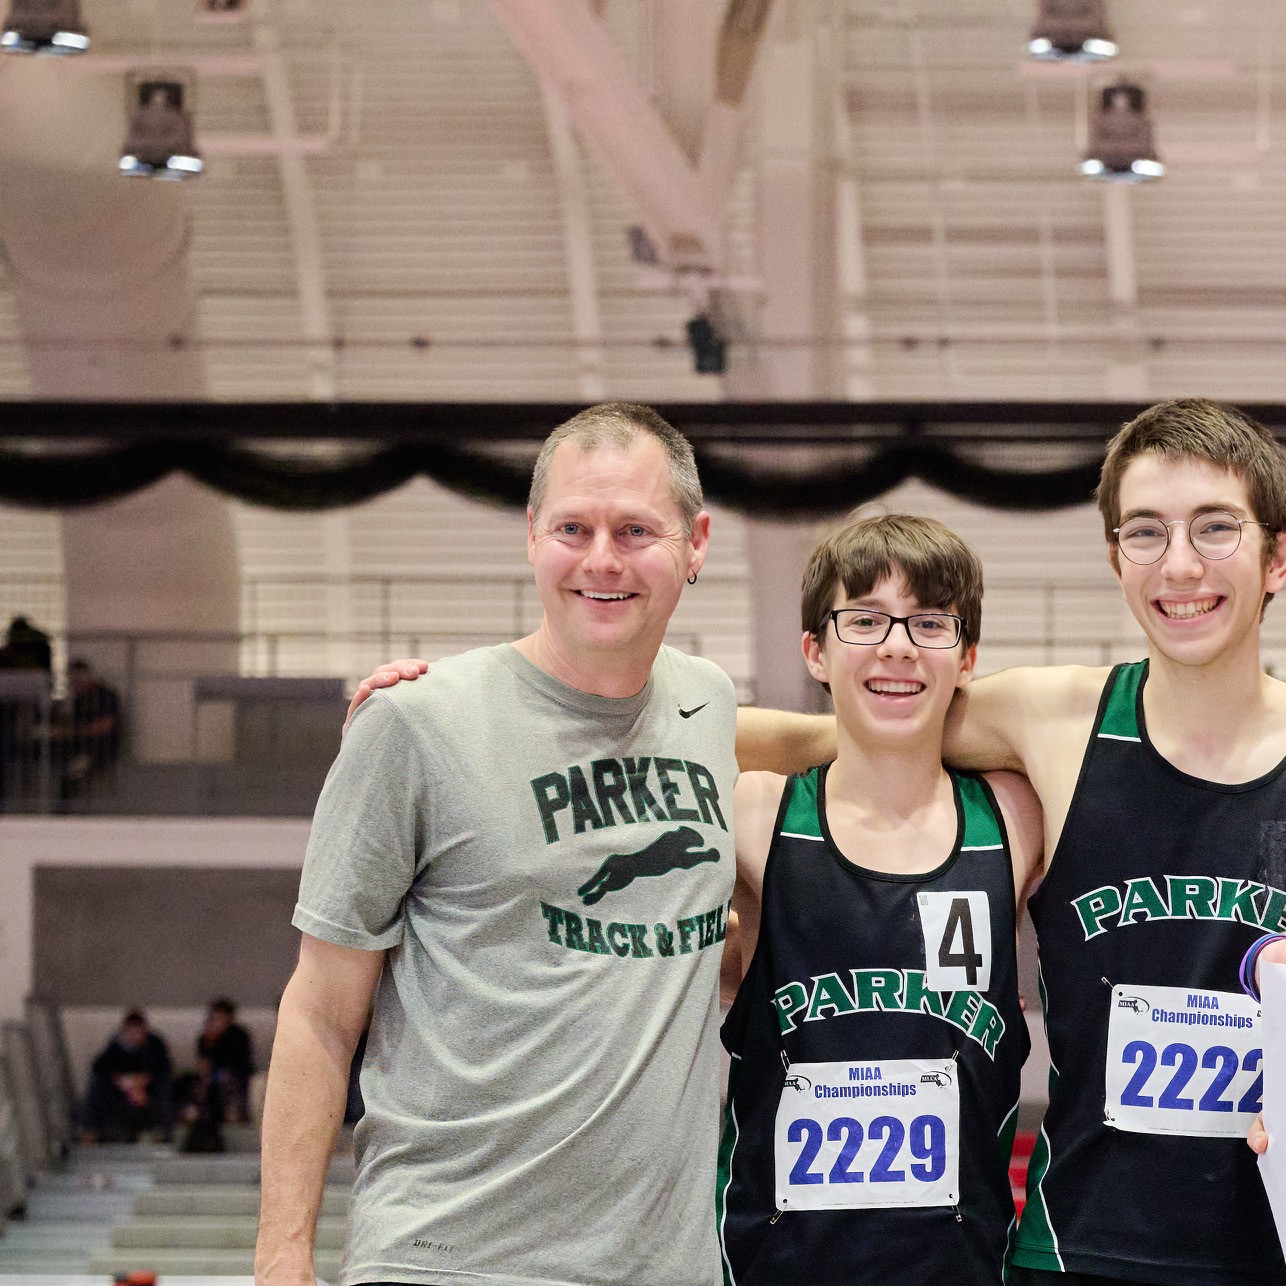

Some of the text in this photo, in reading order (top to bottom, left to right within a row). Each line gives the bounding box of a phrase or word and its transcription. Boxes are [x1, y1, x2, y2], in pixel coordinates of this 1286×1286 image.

[530, 756, 729, 845] PARKER
[540, 900, 731, 958] TRACK & FIEL
[938, 898, 983, 986] 4
[771, 968, 1006, 1062] PARKER
[1151, 1008, 1253, 1029] Championships
[1187, 994, 1219, 1010] MIAA
[814, 1082, 917, 1099] Championships
[849, 1067, 882, 1080] MIAA
[1120, 1040, 1263, 1113] 2222
[787, 1114, 946, 1186] 2229
